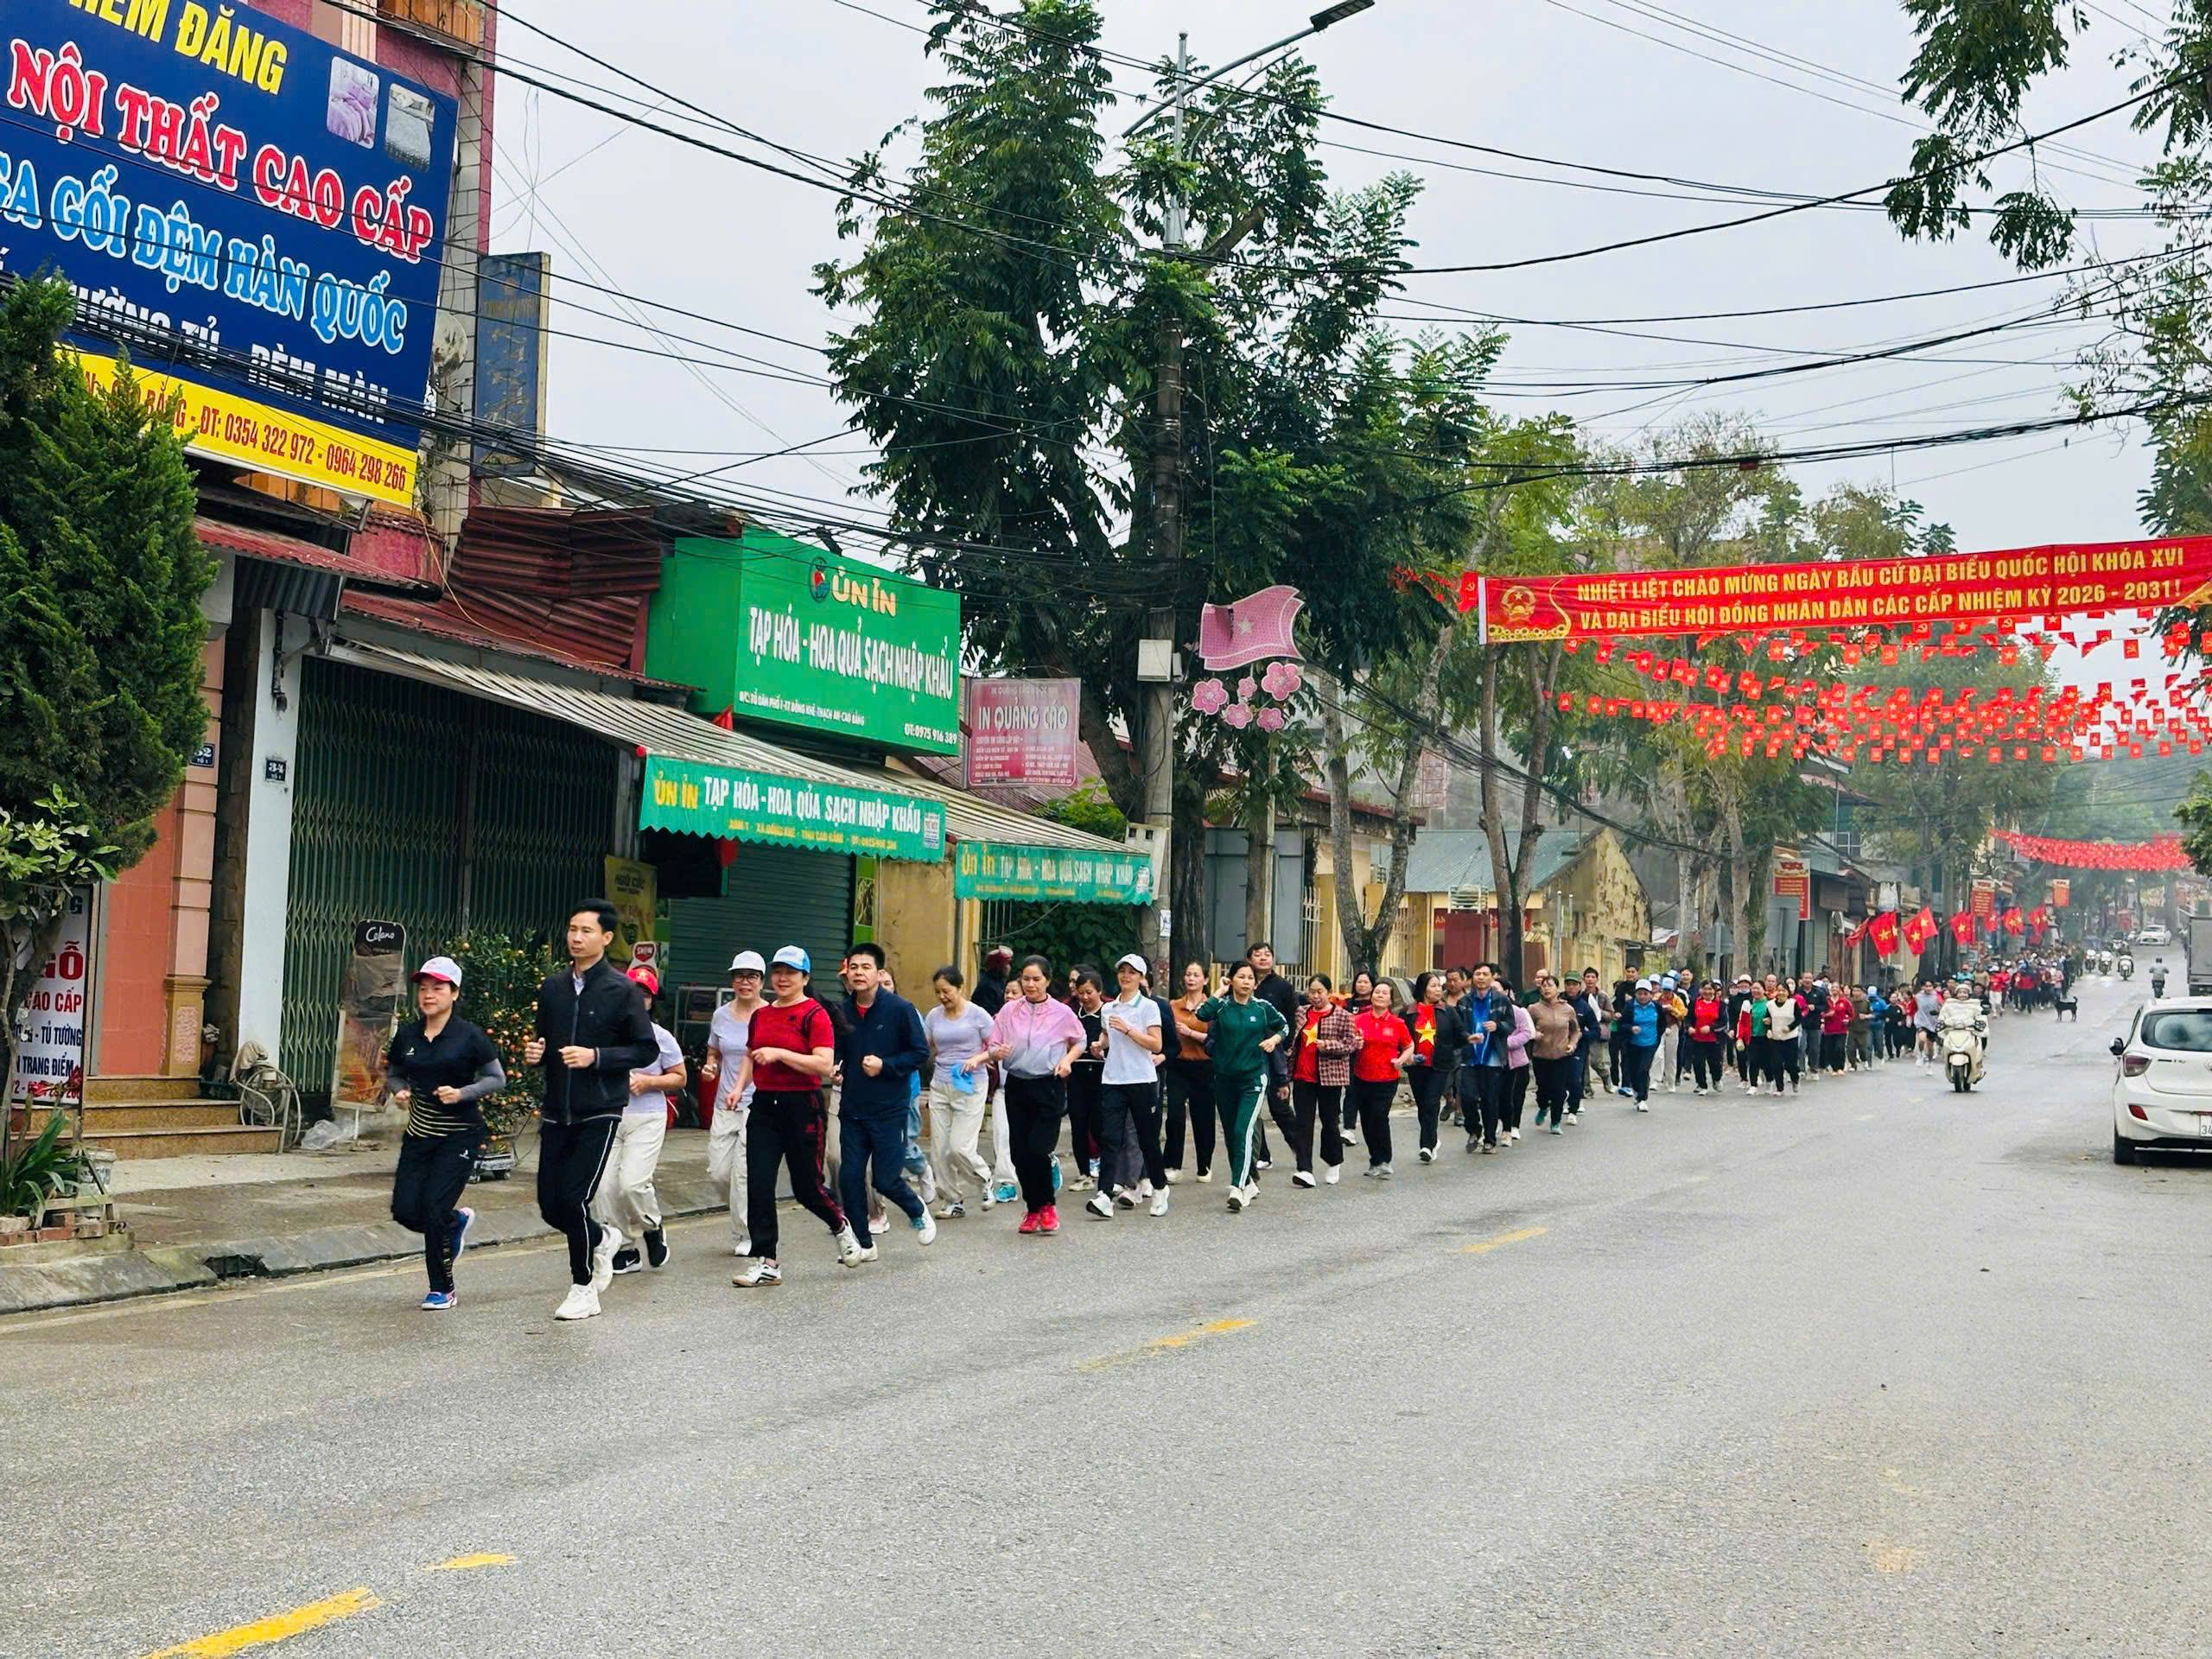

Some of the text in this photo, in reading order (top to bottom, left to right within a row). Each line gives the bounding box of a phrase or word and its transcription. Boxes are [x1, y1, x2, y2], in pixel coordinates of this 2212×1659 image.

[175, 2, 288, 95] ĐĂNG
[8, 39, 434, 264] NỘI THẤT CAO CẤP
[50, 163, 130, 258] GỐI
[132, 200, 221, 292] ĐỆM
[223, 234, 310, 321] HÀN
[310, 270, 407, 354] QUỐC
[200, 404, 221, 438] ĐT:
[224, 413, 257, 448] 0354
[262, 423, 288, 457] 322
[289, 433, 315, 465] 972
[326, 443, 356, 477] 0964
[359, 454, 382, 485] 298
[384, 461, 407, 492] 266
[1577, 545, 2184, 604] NHIỆT LIỆT CHÀO MỪNG NGÀY BẦU CỬ ĐẠI BIỂU QUỐC HỘI KHÓA XVI
[1580, 607, 1600, 631] VÀ
[1606, 609, 1636, 632] ĐẠI
[1640, 601, 1681, 628] BIỂU
[1685, 603, 1715, 627] HỘI
[1719, 600, 1769, 625] ĐỒNG
[1773, 595, 1825, 621] NHÂN
[1829, 594, 1867, 619] DÂN
[1872, 591, 1910, 615] CÁC
[1915, 588, 1954, 613] CẤP
[1958, 589, 2020, 613] NHIỆM
[2027, 584, 2052, 607] KỲ
[2057, 583, 2106, 606] 2026
[2124, 579, 2182, 601] 2031!
[749, 607, 772, 667] TẠP
[773, 603, 801, 664] HÓA
[809, 622, 835, 672] HOA
[837, 615, 862, 678] QUẢ
[865, 637, 893, 695] SẠCH
[895, 641, 924, 703] NHẬP
[925, 635, 954, 700] KHẨU
[978, 696, 1069, 733] IN QUẢNG CÁO
[704, 776, 730, 812] TẠP
[733, 776, 759, 811] HÓA
[767, 785, 792, 817] HOA
[825, 794, 855, 827] SẠCH
[858, 797, 889, 832] NHẬP
[54, 987, 83, 1013] CẤP
[22, 1052, 74, 1077] TRANG ĐIỂM
